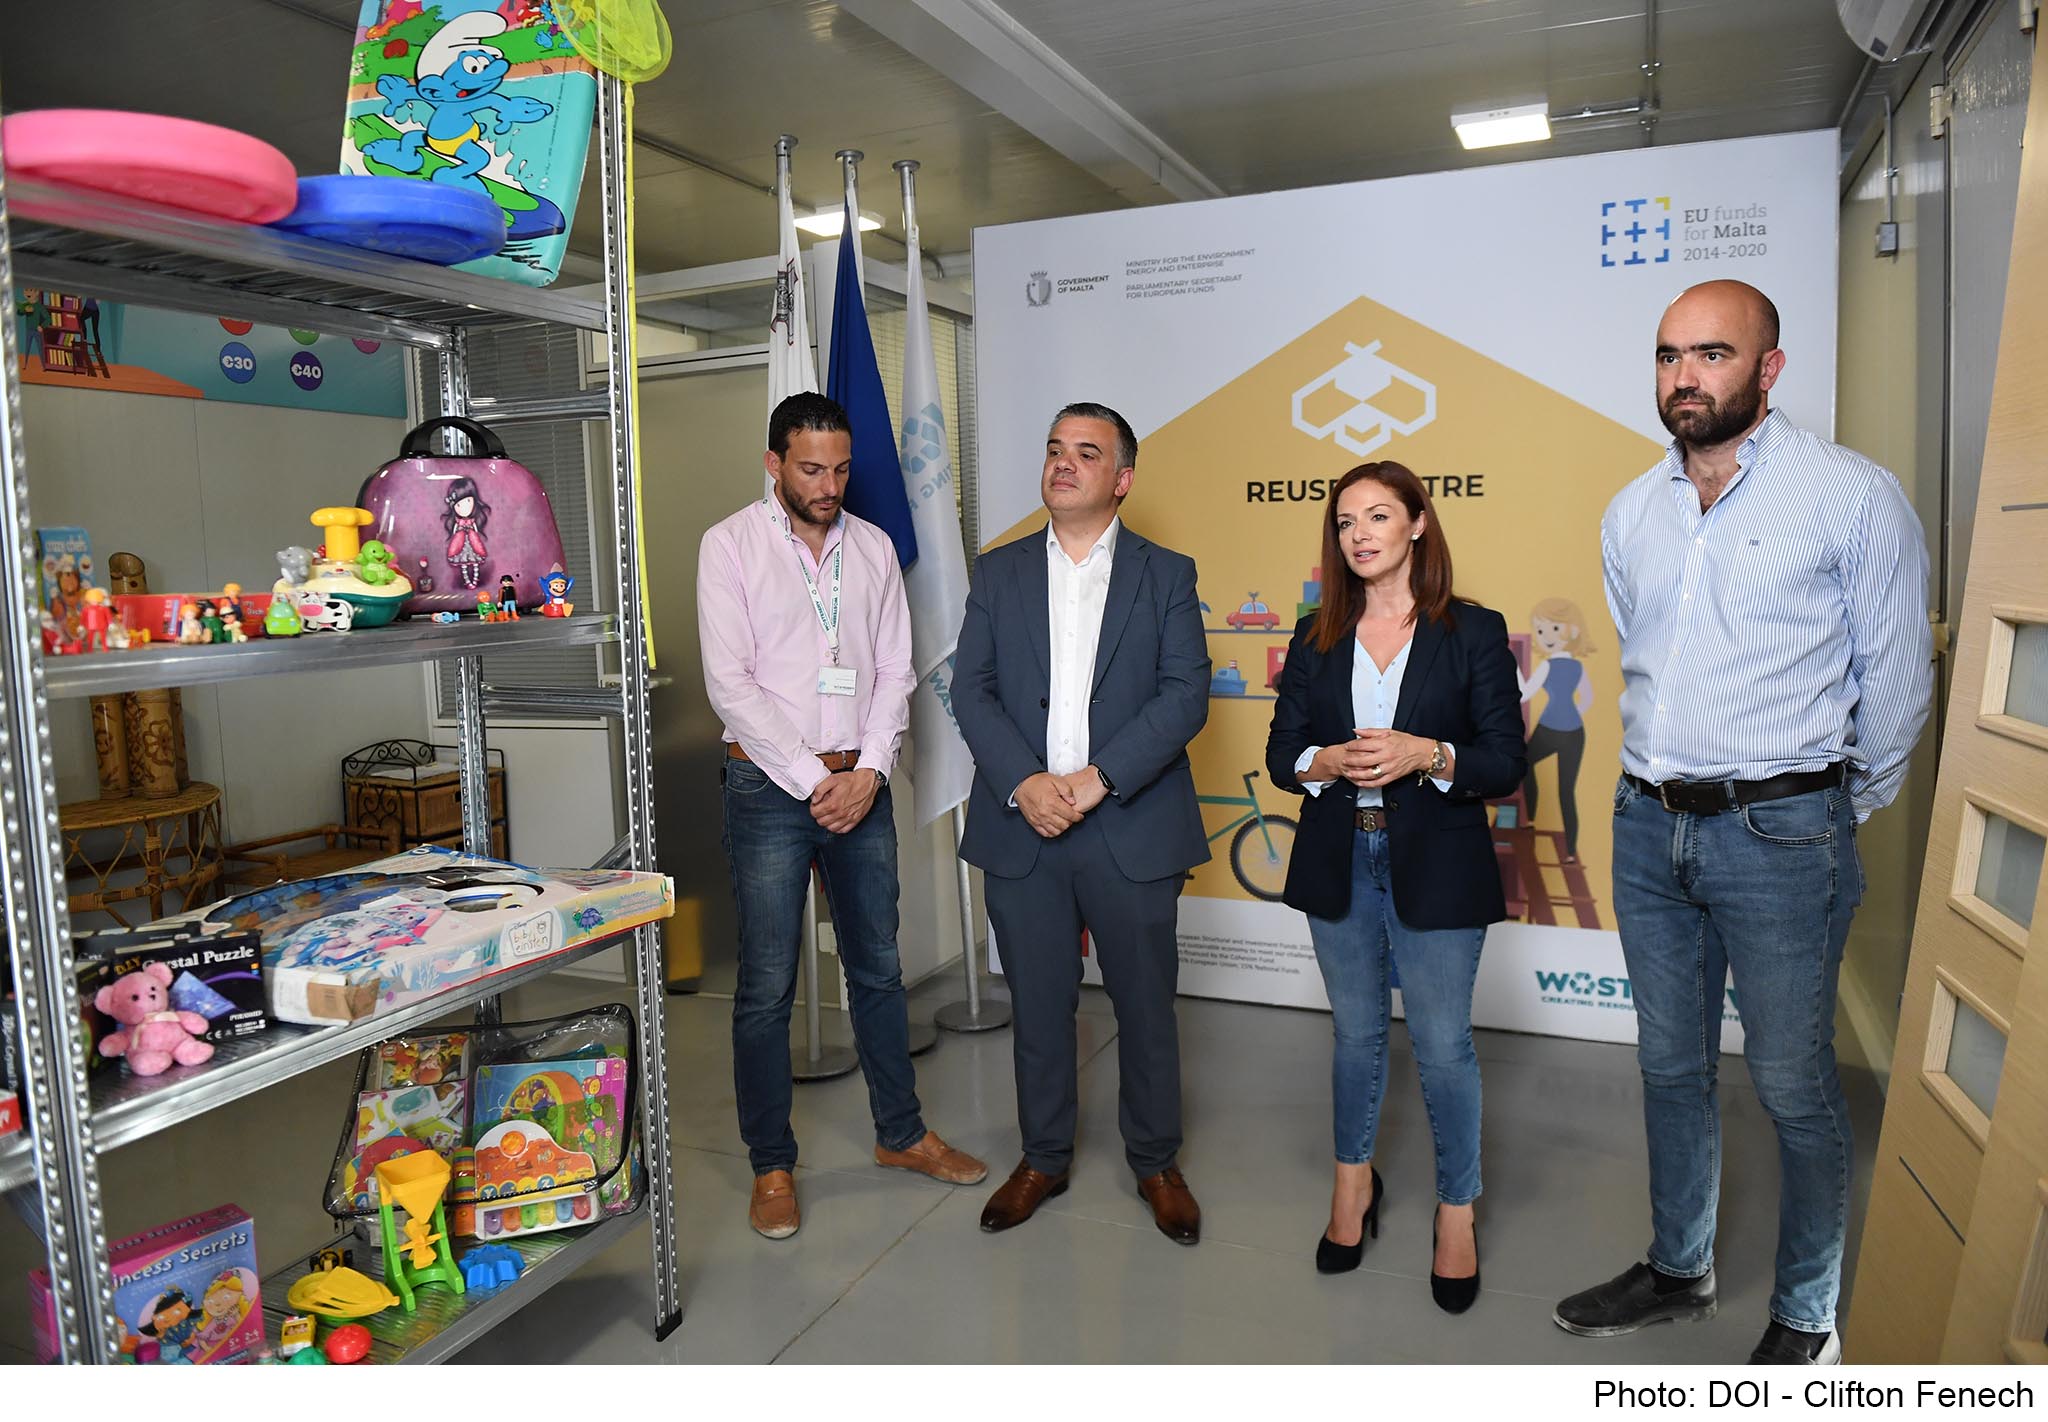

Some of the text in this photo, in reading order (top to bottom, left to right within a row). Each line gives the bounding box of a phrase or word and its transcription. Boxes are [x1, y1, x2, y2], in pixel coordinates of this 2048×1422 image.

[1683, 202, 1767, 223] EU funds
[1684, 221, 1767, 241] for Malta
[1126, 248, 1256, 267] MINISTRY FOR THE ENVIRONMENT
[1683, 242, 1767, 261] 2014-2020
[1126, 260, 1224, 276] ENERGY AND ENTERPRISE
[1057, 274, 1110, 287] GOVERNMENT
[1057, 284, 1094, 294] OF MALTA
[1126, 274, 1243, 291] PARLIAMENTARY SECRETARIAT
[1126, 285, 1215, 300] FOR EUROPEAN FUNDS
[222, 355, 253, 371] €30
[291, 363, 322, 379] €40
[1421, 475, 1484, 498] TRE
[203, 945, 255, 964] Puzzle
[1598, 1001, 1635, 1011] RESOU
[112, 1258, 174, 1290] incess
[180, 1231, 249, 1264] Secrets
